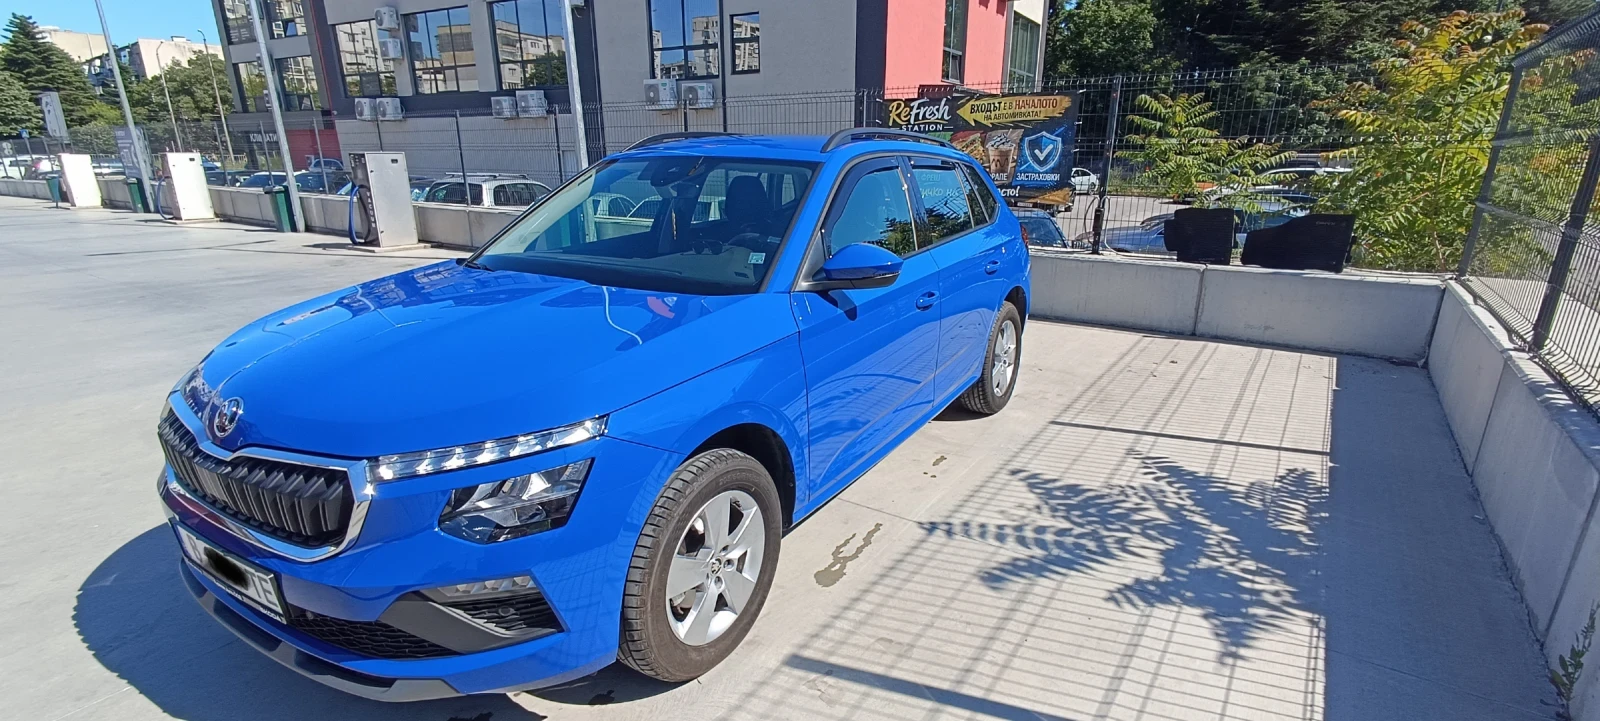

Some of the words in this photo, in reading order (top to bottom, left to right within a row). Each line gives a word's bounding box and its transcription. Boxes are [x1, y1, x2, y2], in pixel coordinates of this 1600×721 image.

[970, 102, 1001, 114] ВХОДЪТ
[1003, 102, 1007, 110] Е
[1008, 102, 1013, 110] В
[1014, 98, 1058, 109] НАЧАЛОТО
[889, 98, 951, 126] ReFresh
[993, 111, 1042, 121] АВТОМИВКАТА!
[990, 172, 1008, 181] РАПЕ
[1016, 173, 1060, 181] ЗАСТРАХОВКИ
